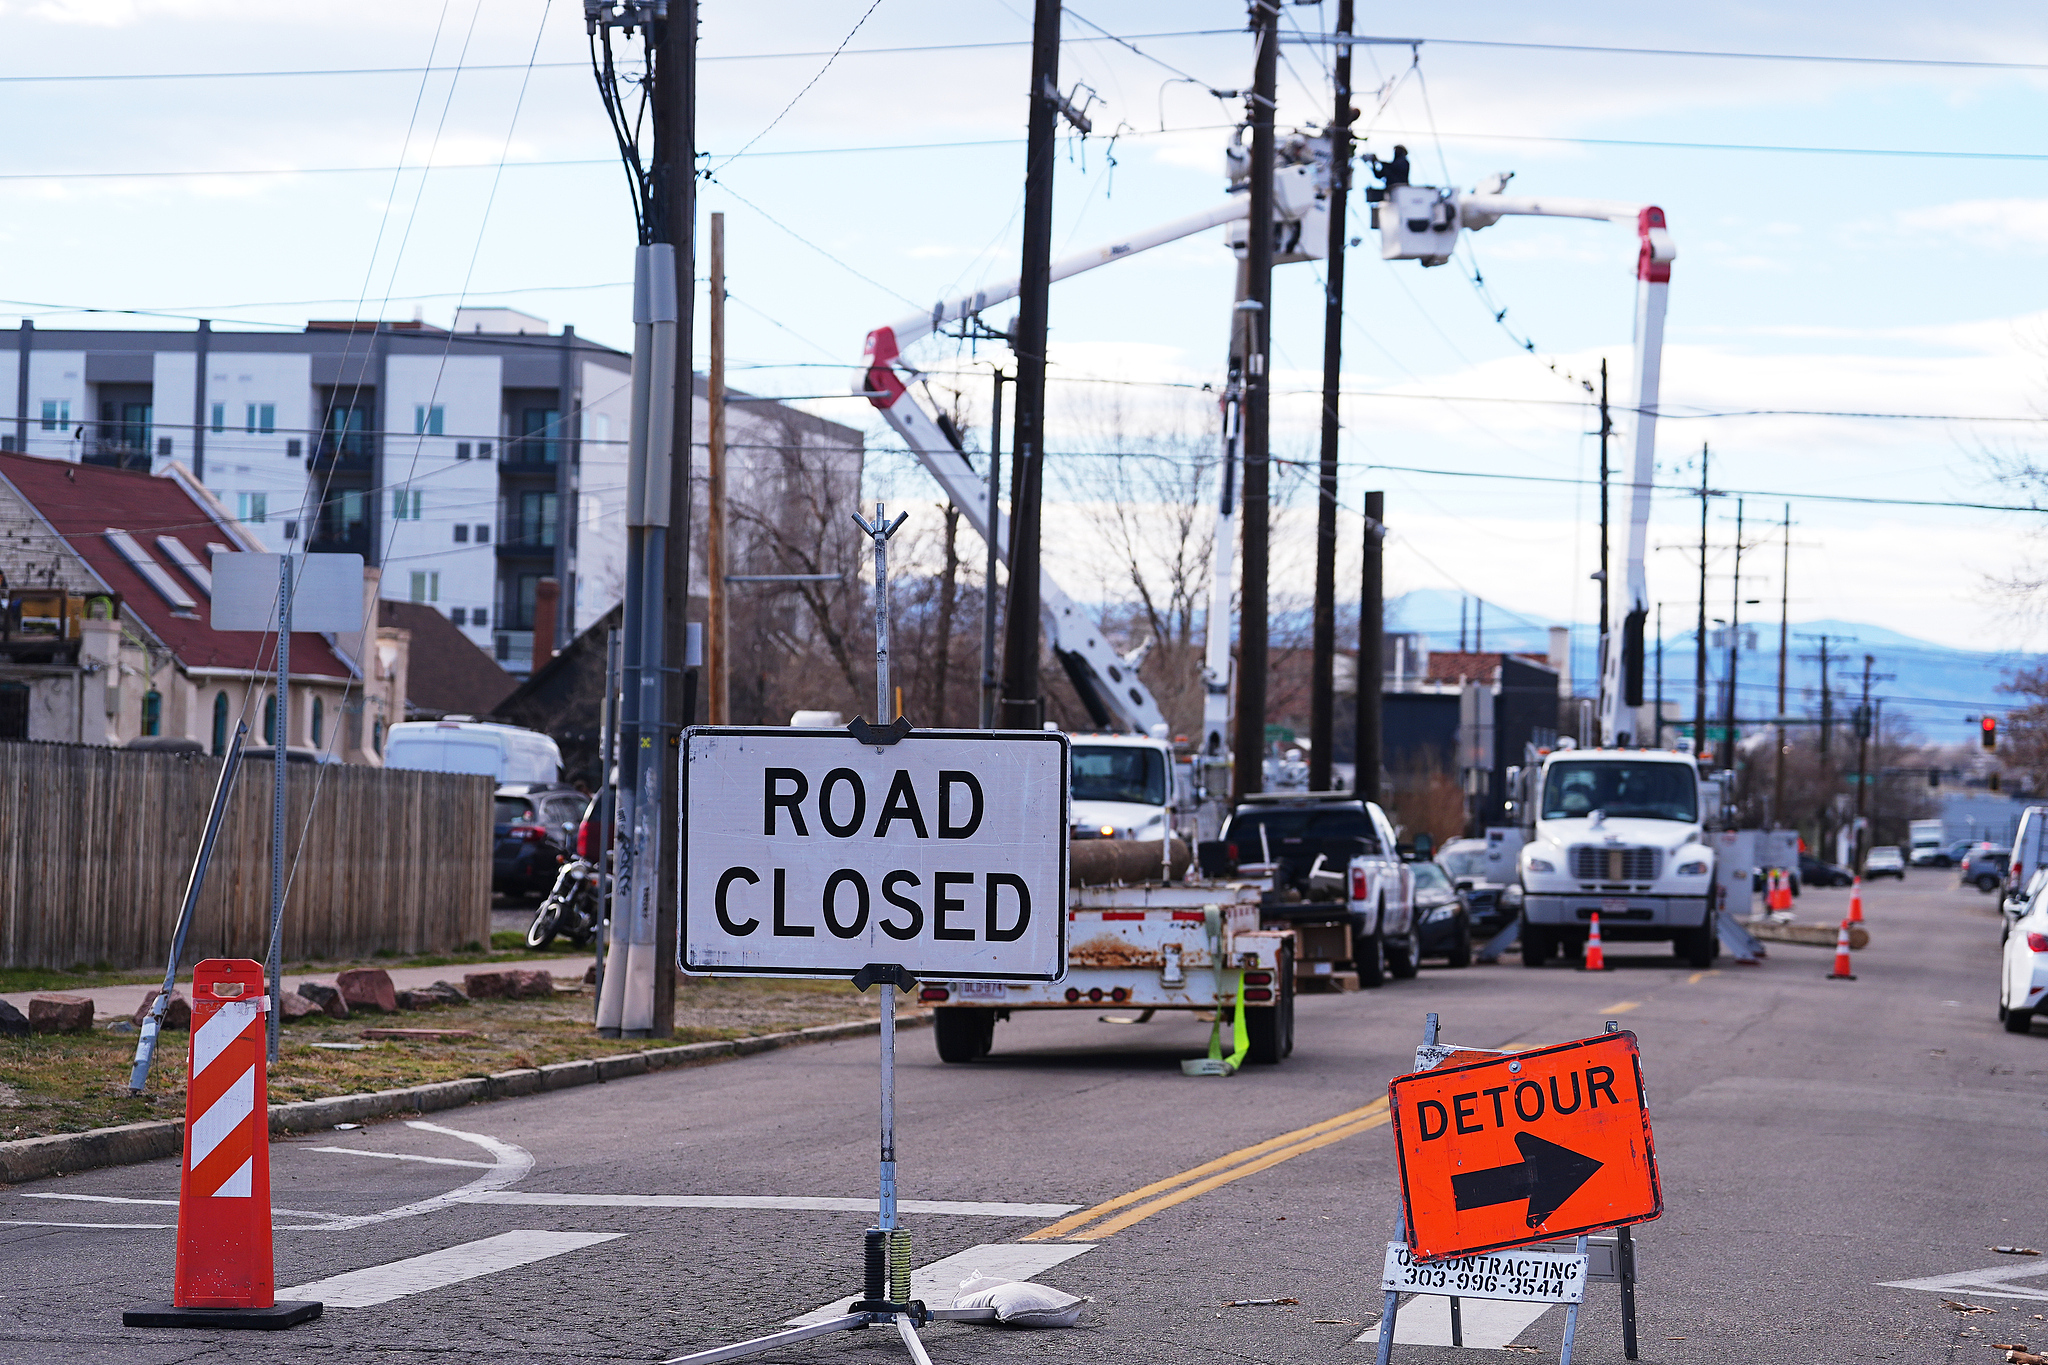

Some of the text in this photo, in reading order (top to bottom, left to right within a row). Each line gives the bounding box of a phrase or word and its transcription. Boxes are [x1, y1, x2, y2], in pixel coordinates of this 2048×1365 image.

[764, 767, 984, 840] ROAD
[715, 866, 1032, 942] CLOSED
[1417, 1066, 1619, 1142] DETOUR
[1404, 1267, 1564, 1298] 303-996-3544
